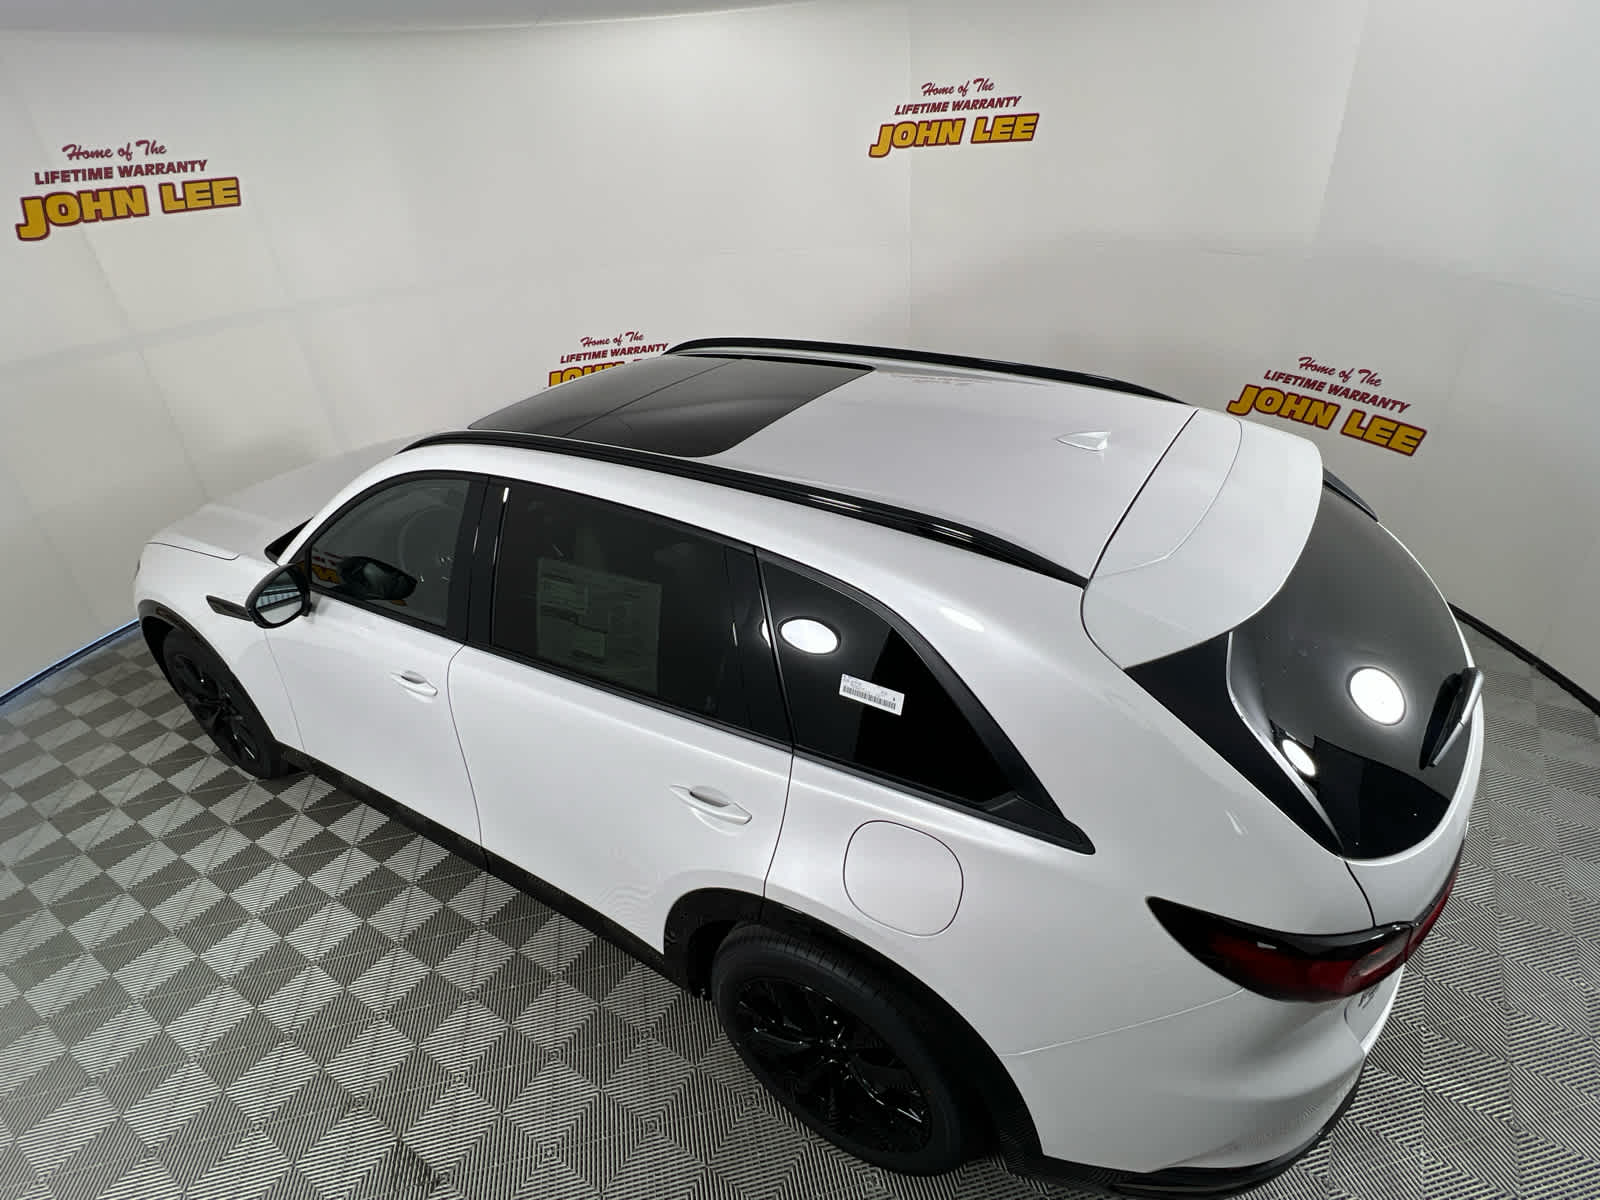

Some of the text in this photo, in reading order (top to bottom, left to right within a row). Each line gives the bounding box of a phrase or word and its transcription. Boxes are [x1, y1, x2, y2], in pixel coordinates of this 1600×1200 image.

[921, 77, 995, 97] Home of The
[894, 95, 1022, 115] LIFETIME WARRANTY
[869, 113, 1040, 158] JOHN LEE
[62, 140, 168, 161] Home of The
[34, 159, 208, 185] LIFETIME WARRANTY
[15, 176, 242, 241] JOHN LEE
[580, 331, 644, 348] Home of The
[560, 343, 669, 364] LIFETIME WARRANTY
[1298, 356, 1383, 387] Home of The
[1264, 369, 1411, 413] LIFETIME WARRANTY
[1226, 384, 1428, 457] JOHN LEE
